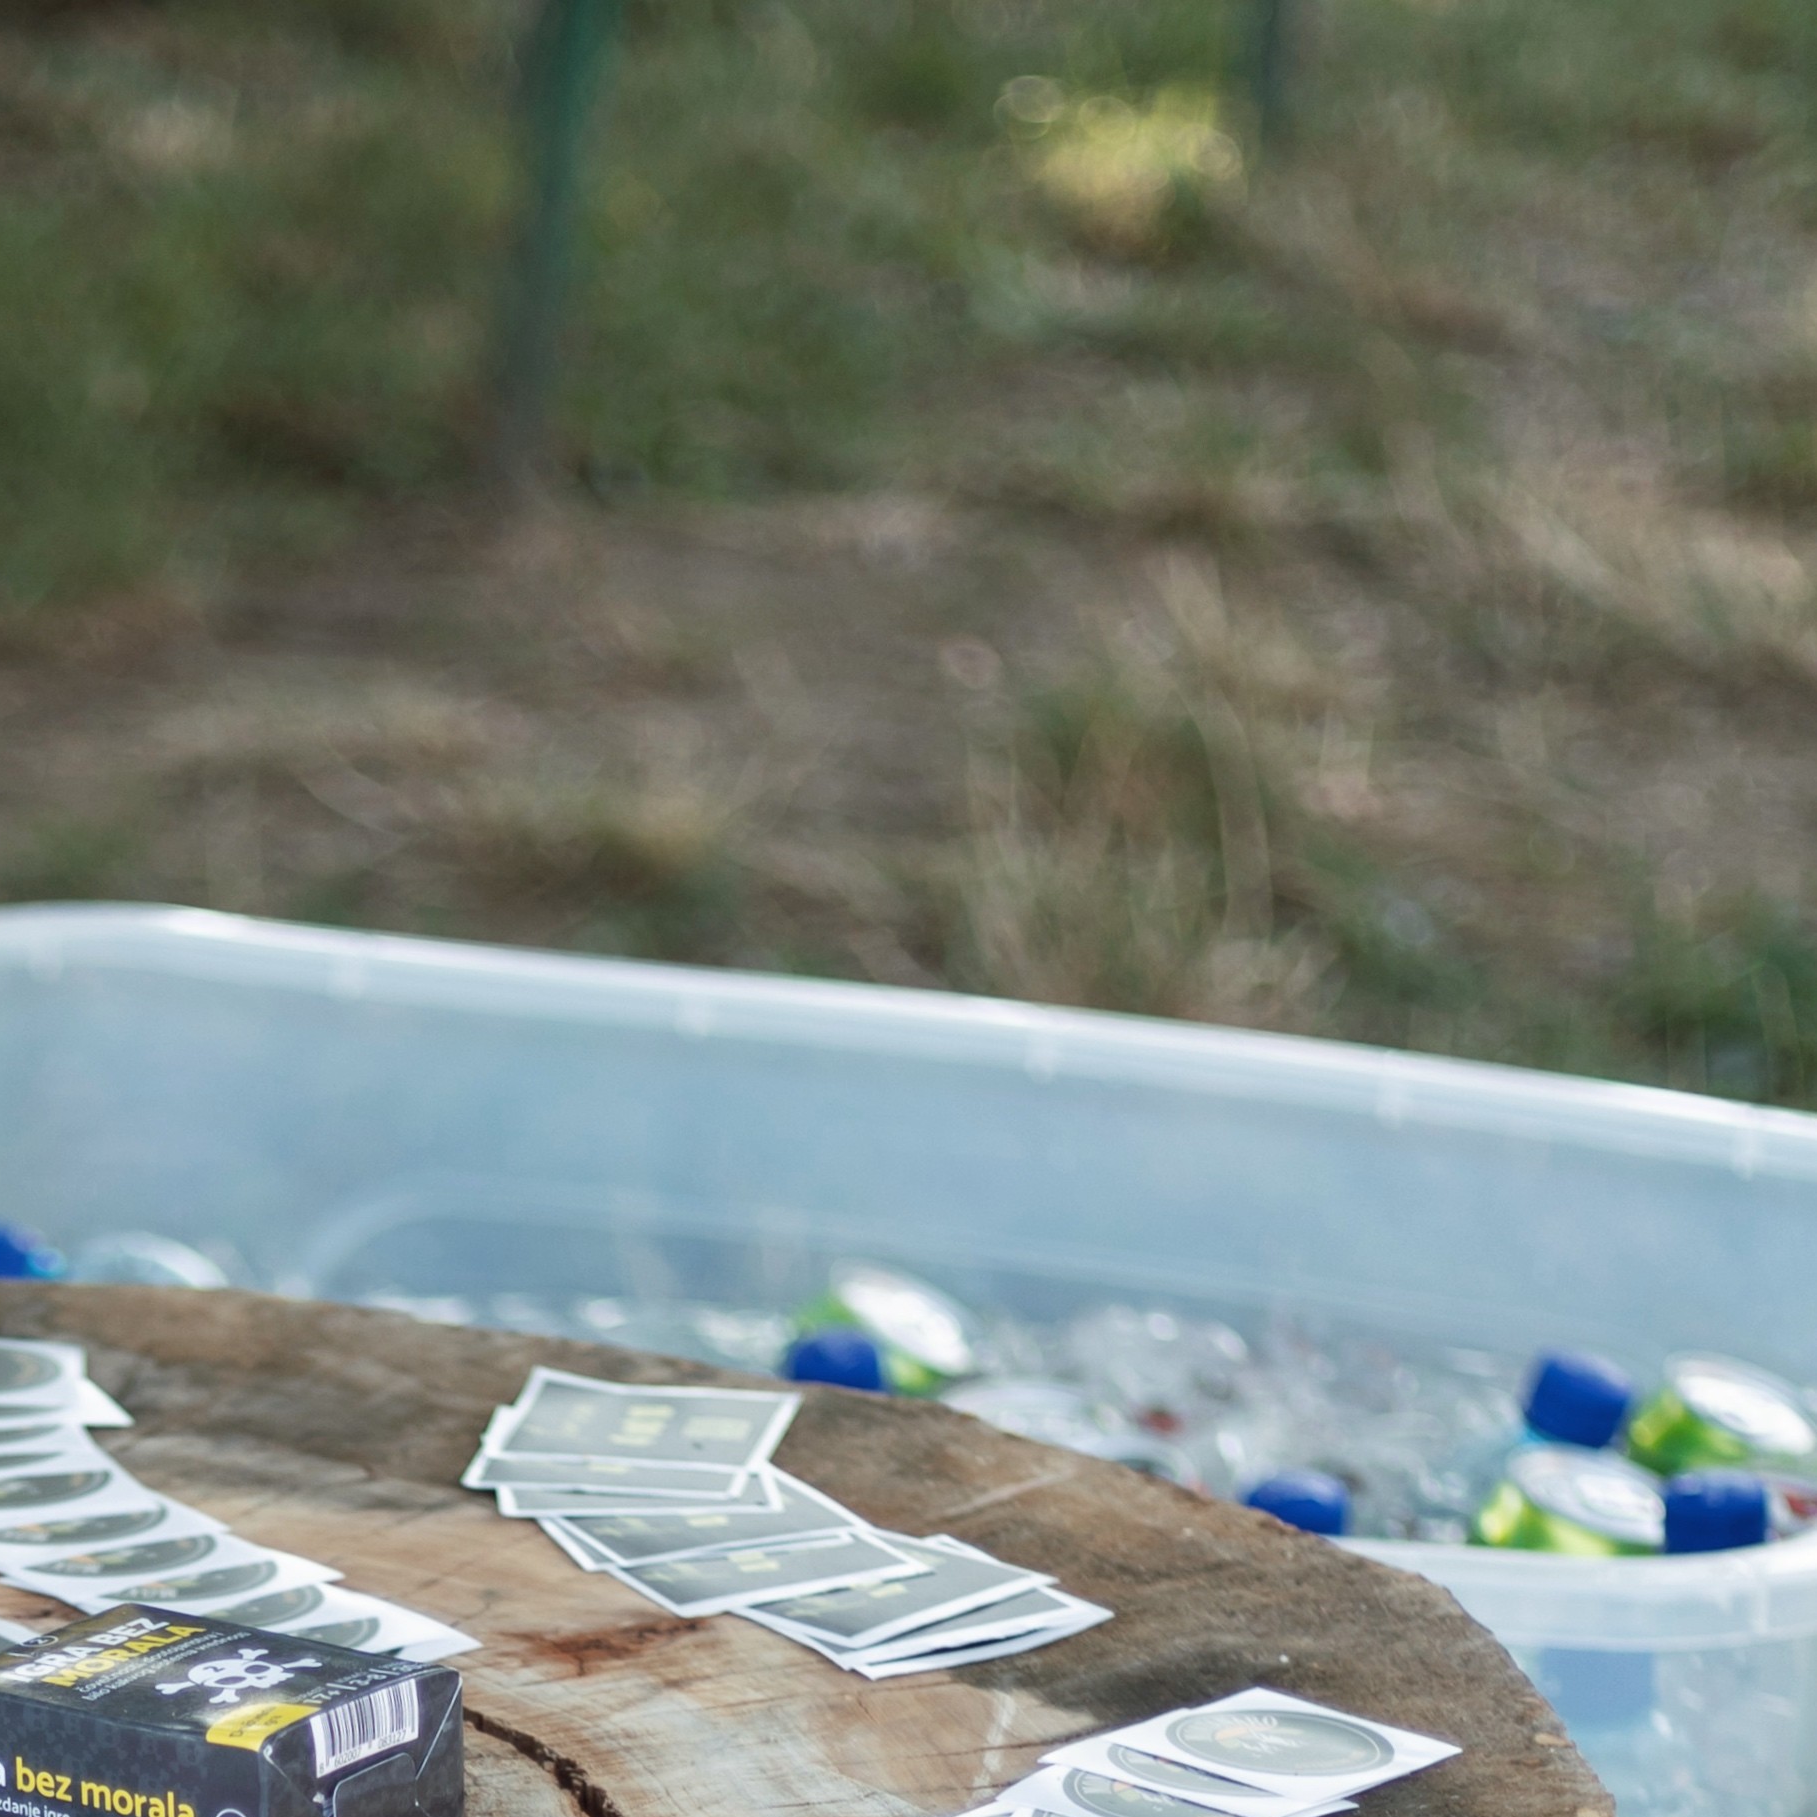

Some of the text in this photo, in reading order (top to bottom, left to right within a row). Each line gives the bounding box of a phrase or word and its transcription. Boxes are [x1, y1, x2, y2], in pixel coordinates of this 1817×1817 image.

[0, 1617, 170, 1683] IGRA BEZ
[41, 1625, 206, 1687] MORALA
[16, 1757, 72, 1802] bez
